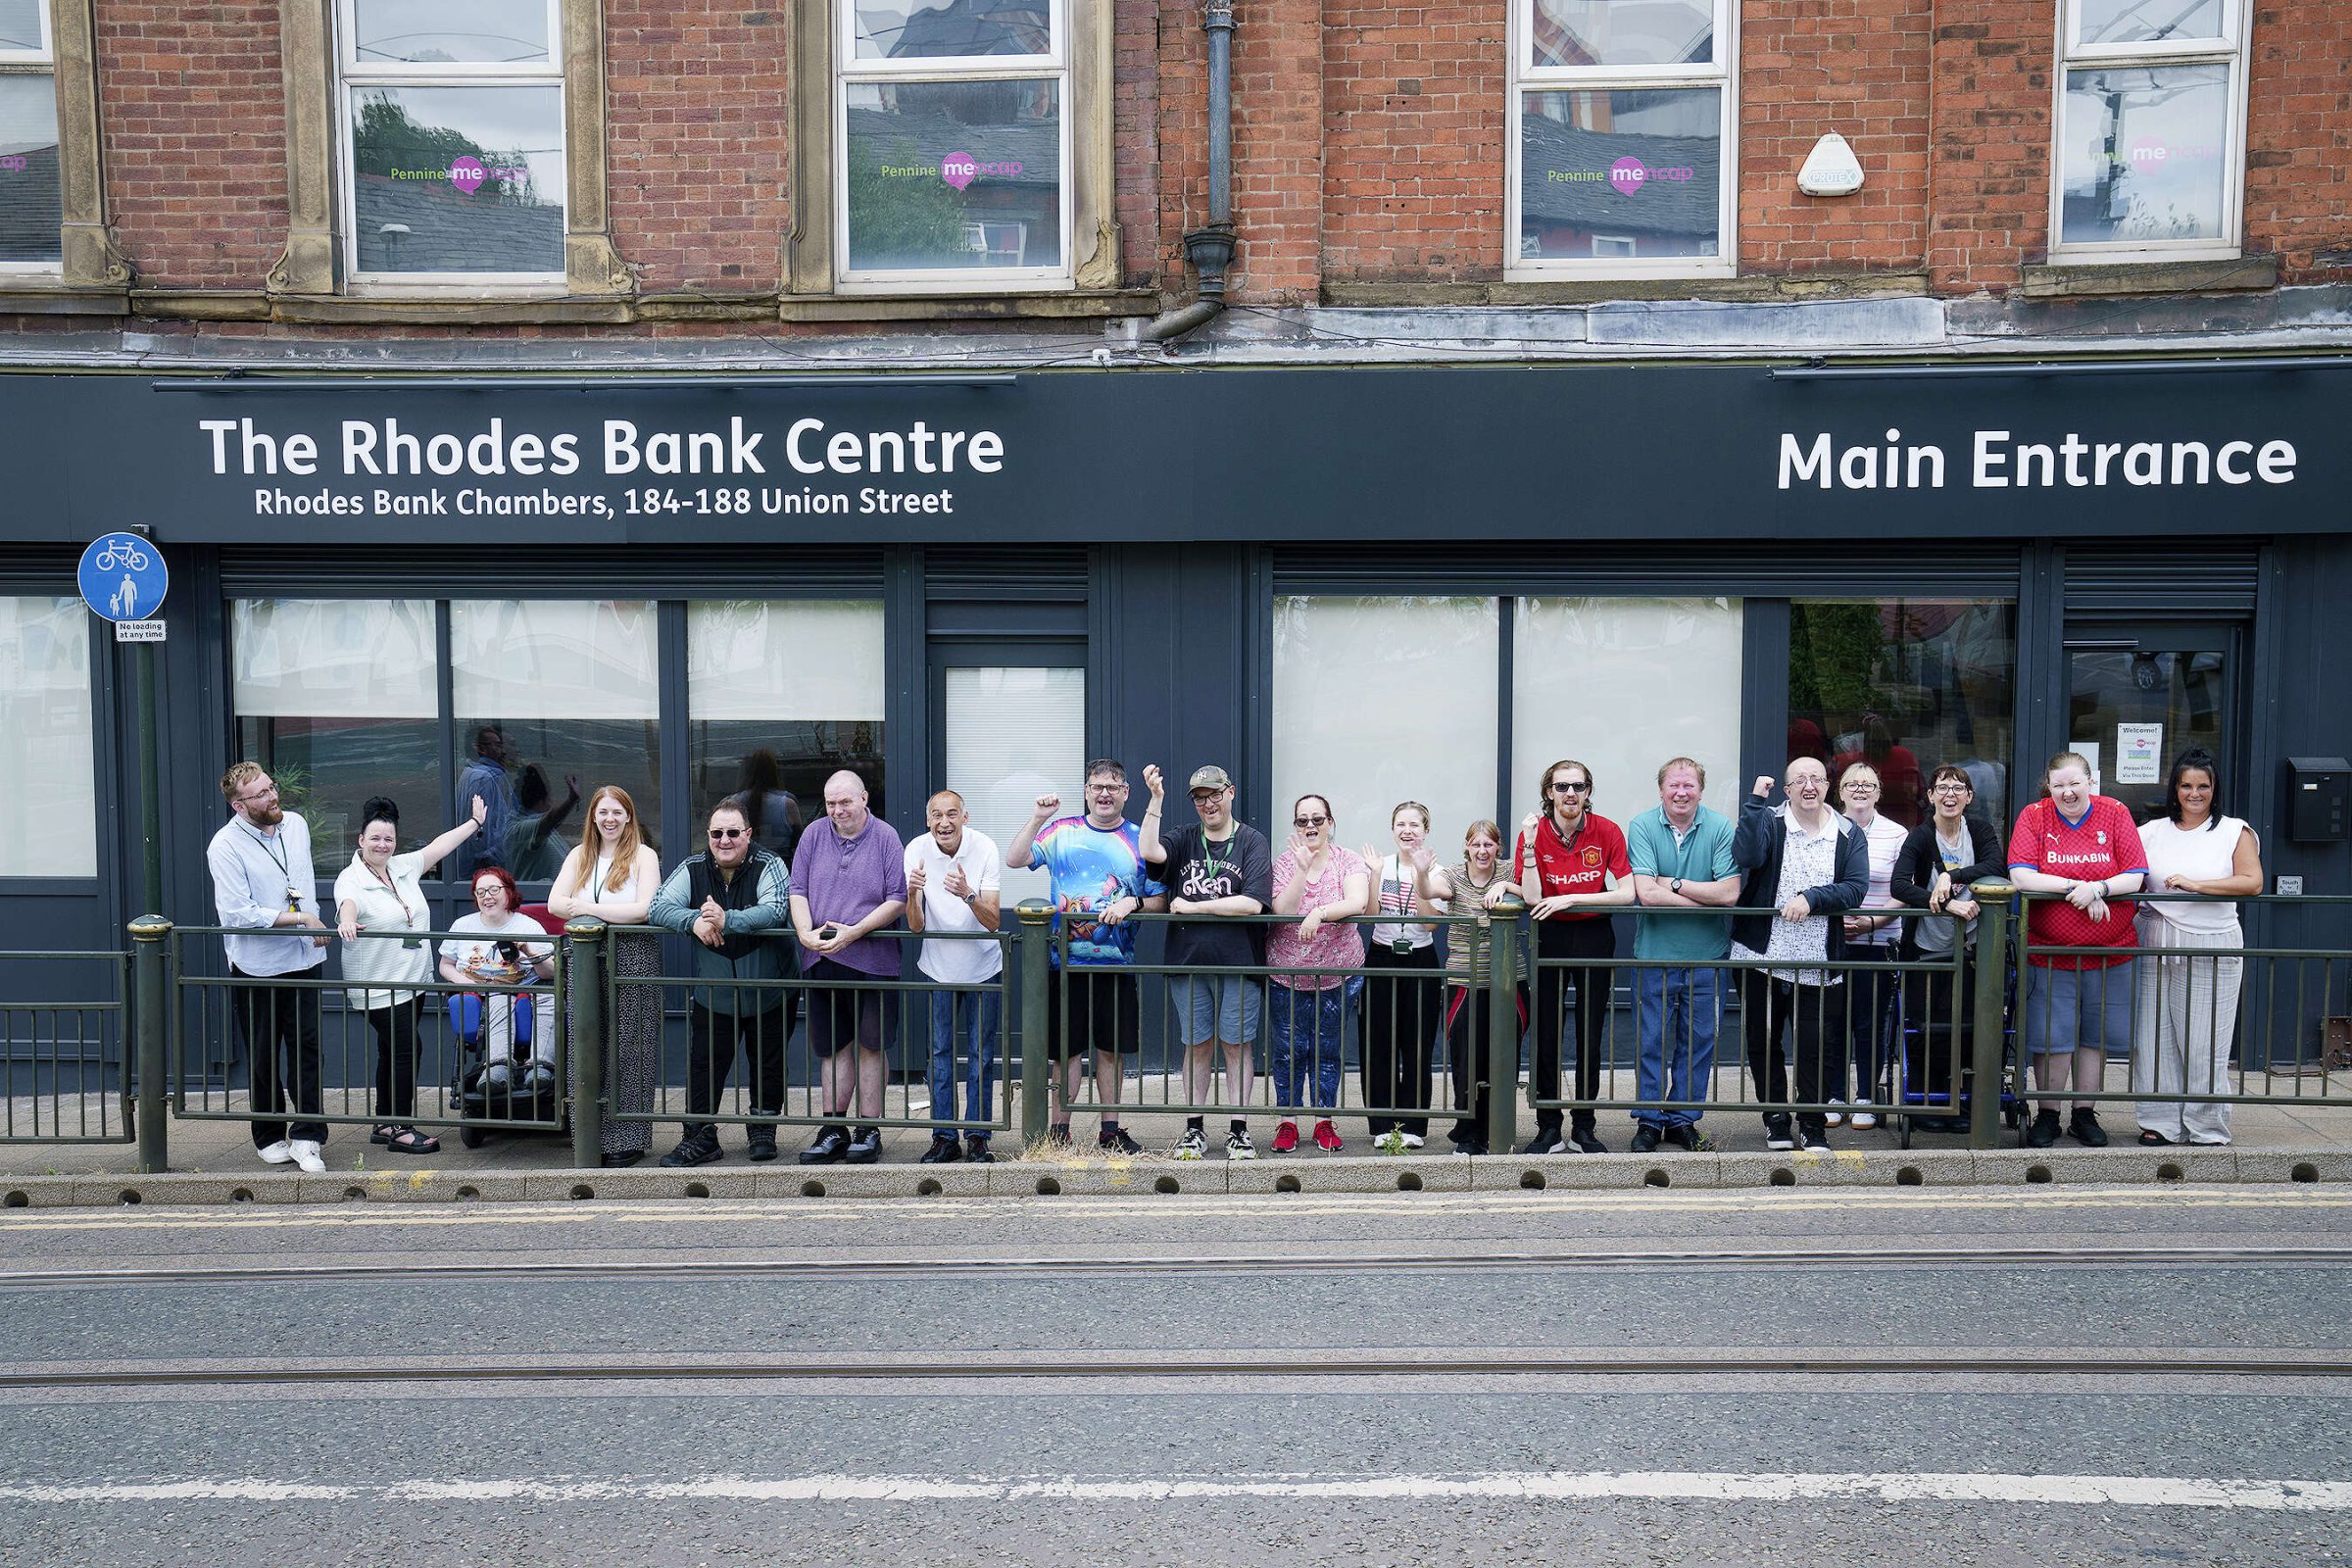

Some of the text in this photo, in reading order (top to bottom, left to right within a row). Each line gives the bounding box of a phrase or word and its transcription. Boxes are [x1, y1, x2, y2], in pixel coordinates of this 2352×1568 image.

[391, 168, 445, 180] Pennine
[882, 162, 1023, 178] Pennine mencap
[1547, 167, 1693, 183] Pennine mencap
[1812, 170, 1857, 184] PROTEX
[200, 416, 1004, 474] The Rhodes Bank Centre
[1779, 428, 2296, 489] Main Entrance
[256, 487, 953, 520] Rhodes Bank Chambers, 184-188 Union Street
[2047, 851, 2110, 863] BUNKABIN
[1183, 867, 1232, 896] Ken
[1546, 870, 1601, 885] SHARP
